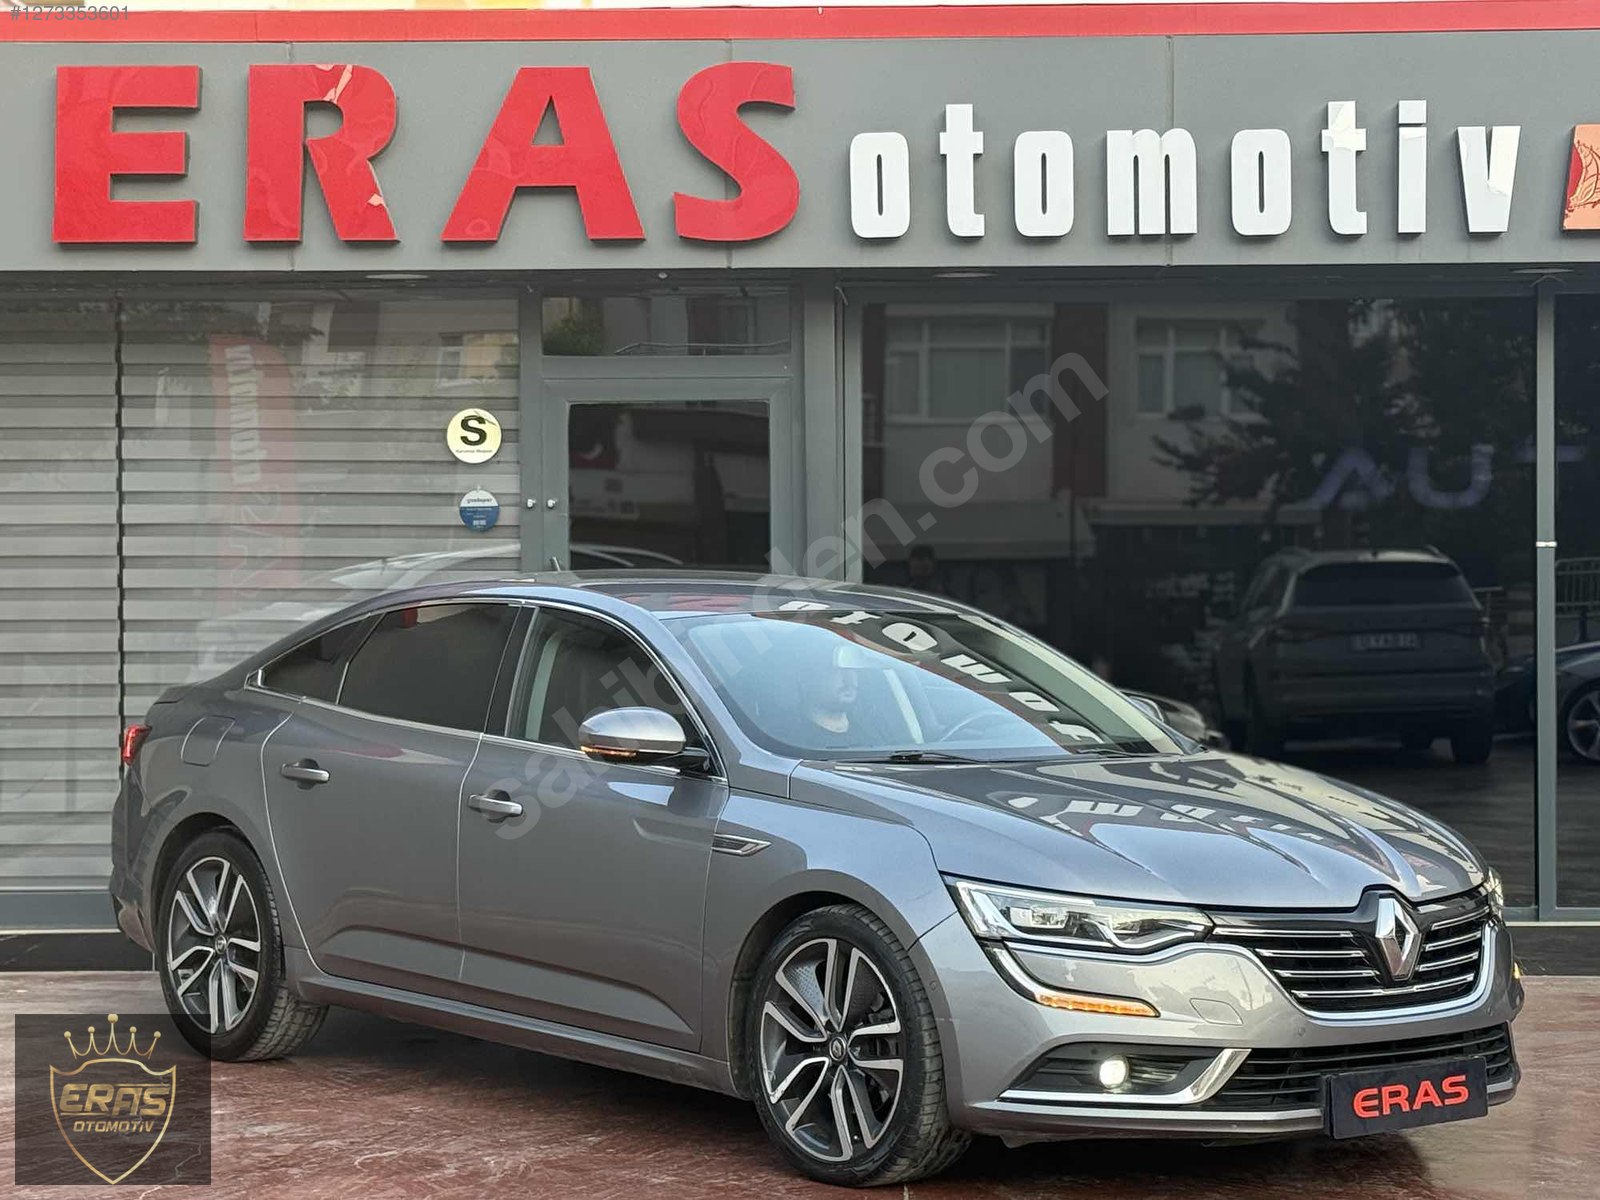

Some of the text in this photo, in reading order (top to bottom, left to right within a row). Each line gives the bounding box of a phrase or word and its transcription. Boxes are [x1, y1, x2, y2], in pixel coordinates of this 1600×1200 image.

[52, 61, 1521, 245] ERAS otomotiv
[460, 415, 487, 446] S
[1353, 1074, 1470, 1119] ERAS
